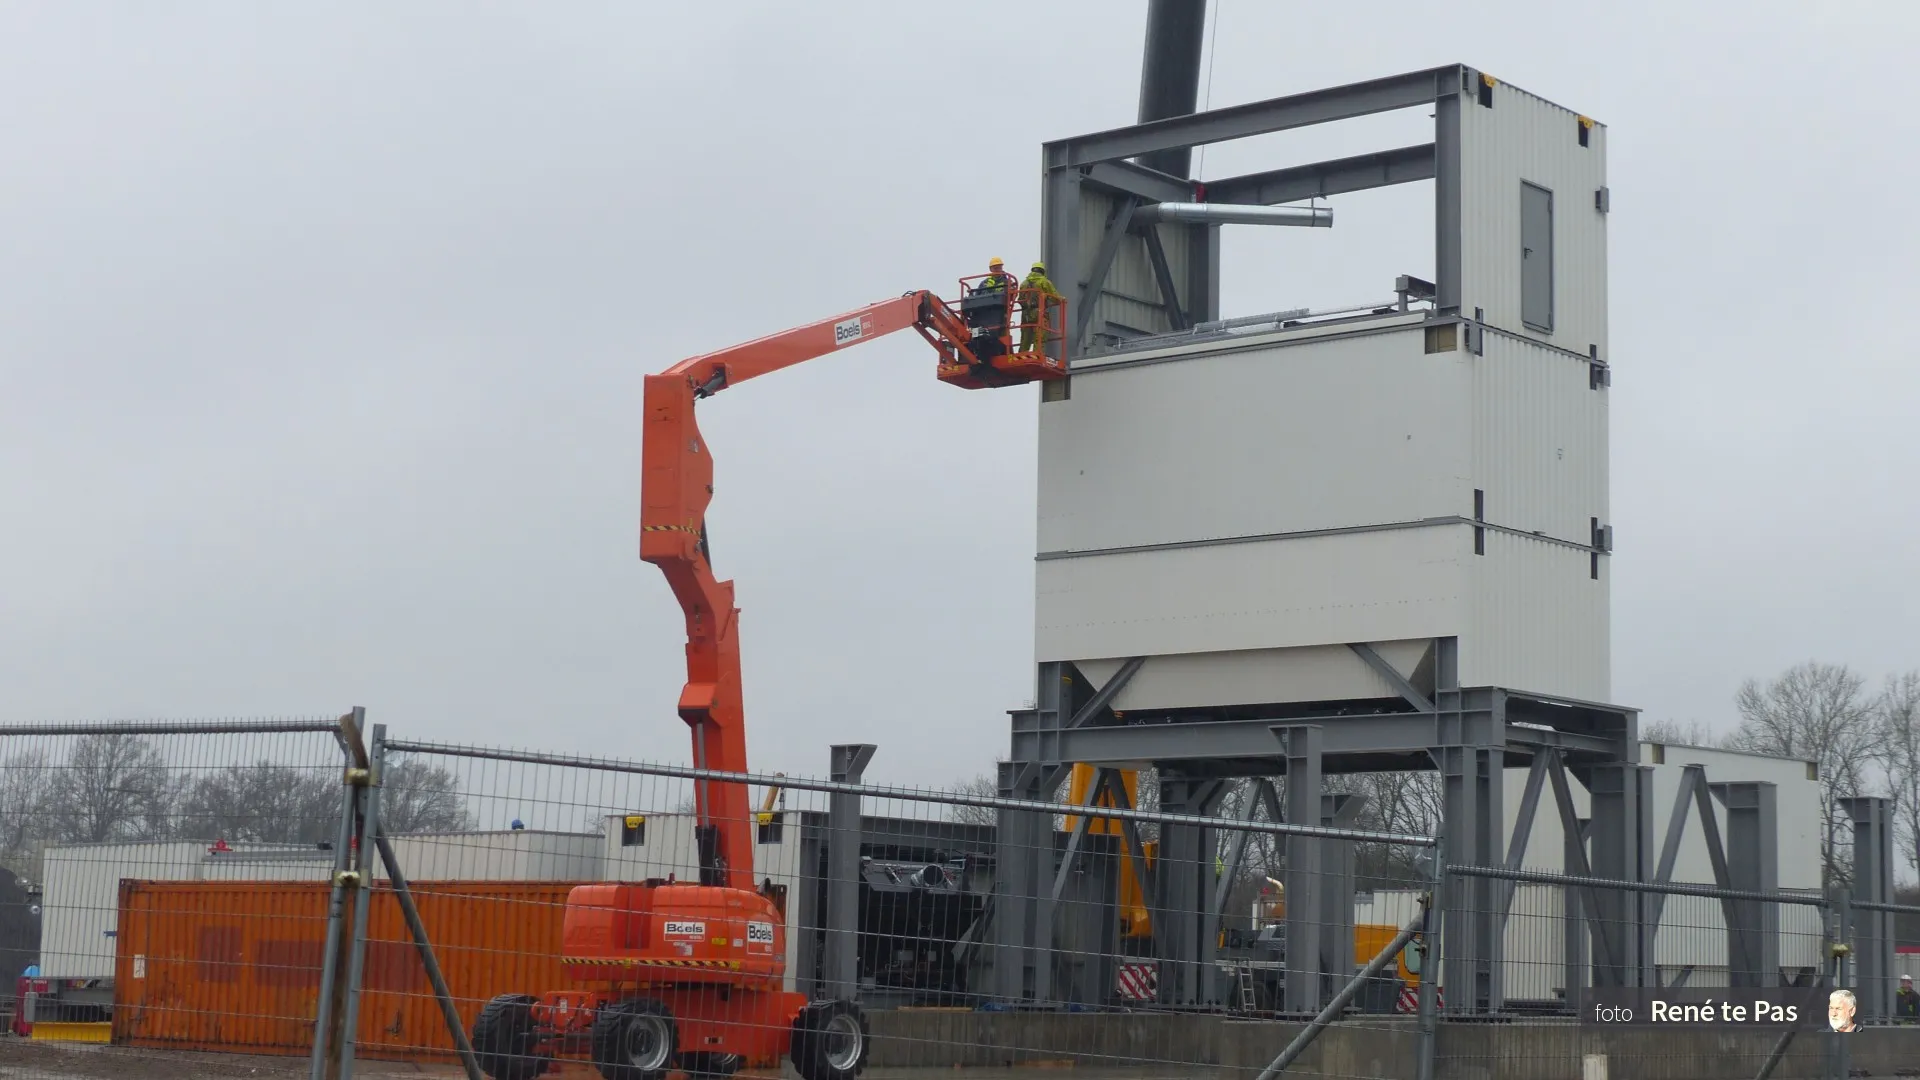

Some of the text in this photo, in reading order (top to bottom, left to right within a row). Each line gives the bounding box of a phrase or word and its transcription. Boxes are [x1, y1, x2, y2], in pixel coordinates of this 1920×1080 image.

[836, 322, 860, 341] Boels
[666, 923, 703, 933] Boels
[748, 925, 772, 941] Boels
